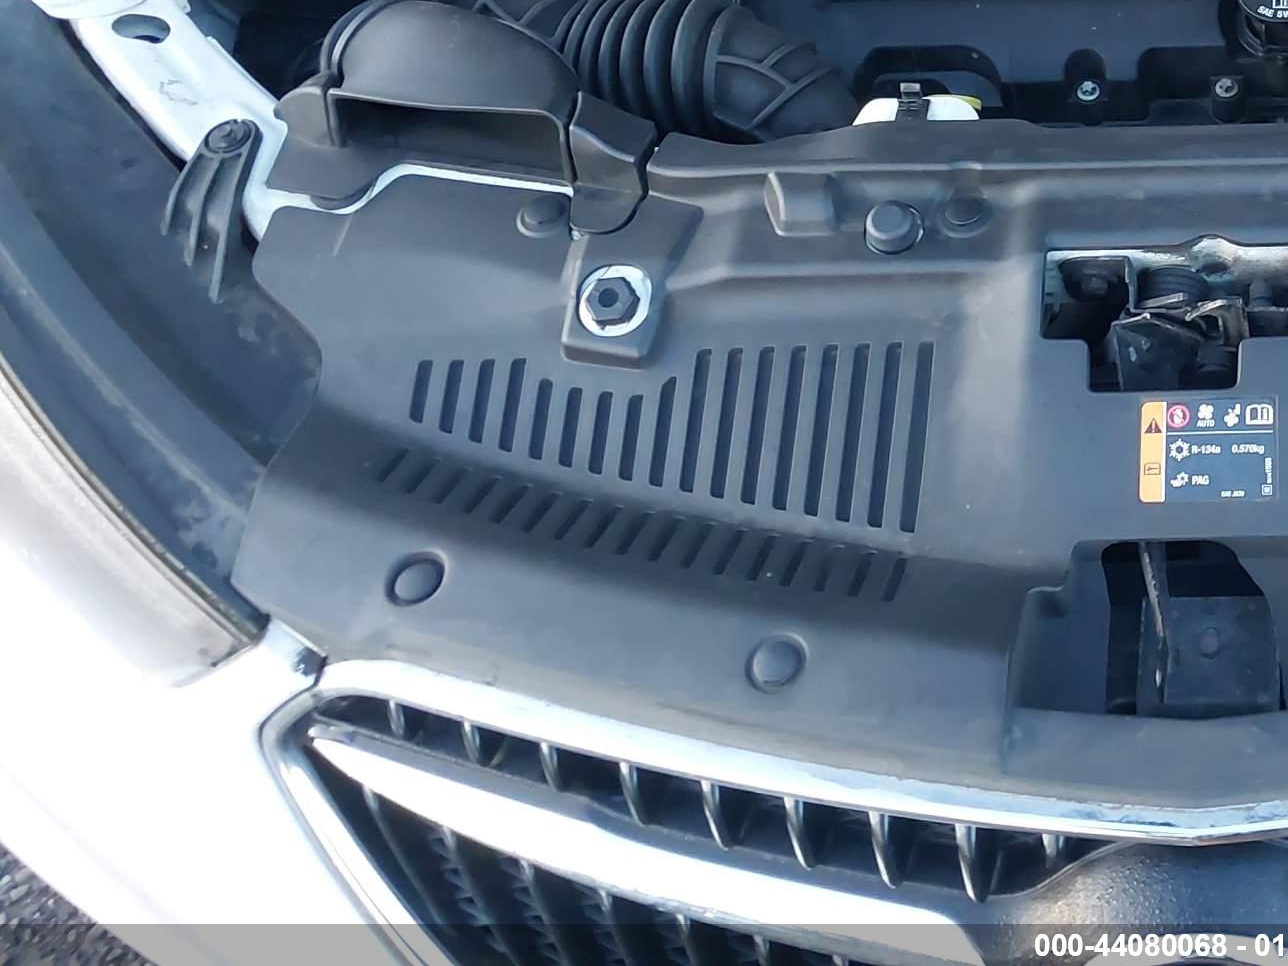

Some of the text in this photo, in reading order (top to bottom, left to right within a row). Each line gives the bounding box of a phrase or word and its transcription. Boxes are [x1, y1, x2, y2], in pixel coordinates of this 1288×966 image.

[1257, 5, 1275, 18] SAE
[1197, 419, 1215, 427] AUTO
[1191, 445, 1221, 454] R-134a
[1192, 475, 1210, 485] PAG
